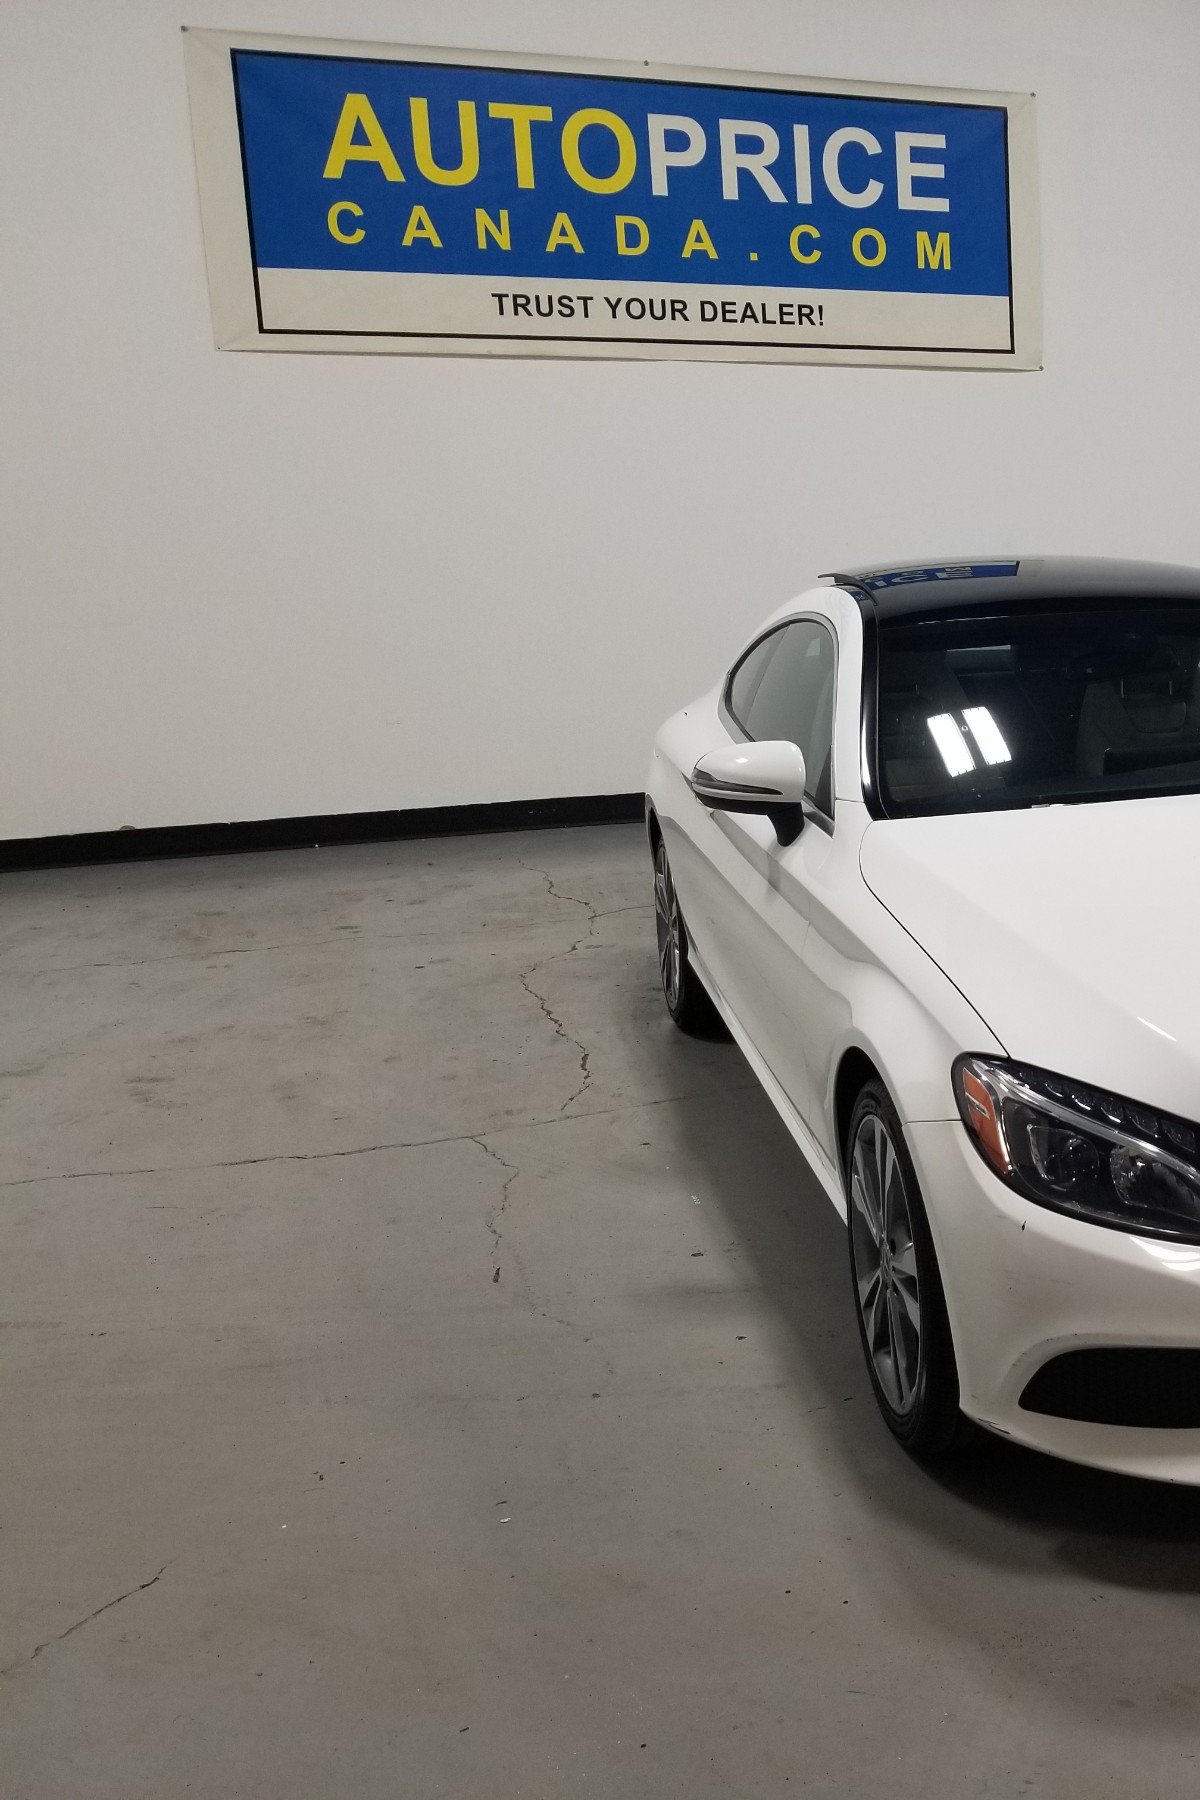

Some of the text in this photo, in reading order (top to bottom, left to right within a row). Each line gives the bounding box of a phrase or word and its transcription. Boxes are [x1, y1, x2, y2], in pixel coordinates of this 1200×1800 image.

[322, 92, 950, 213] AUTOPRICE
[490, 292, 825, 327] TRUST YOUR DEALER!
